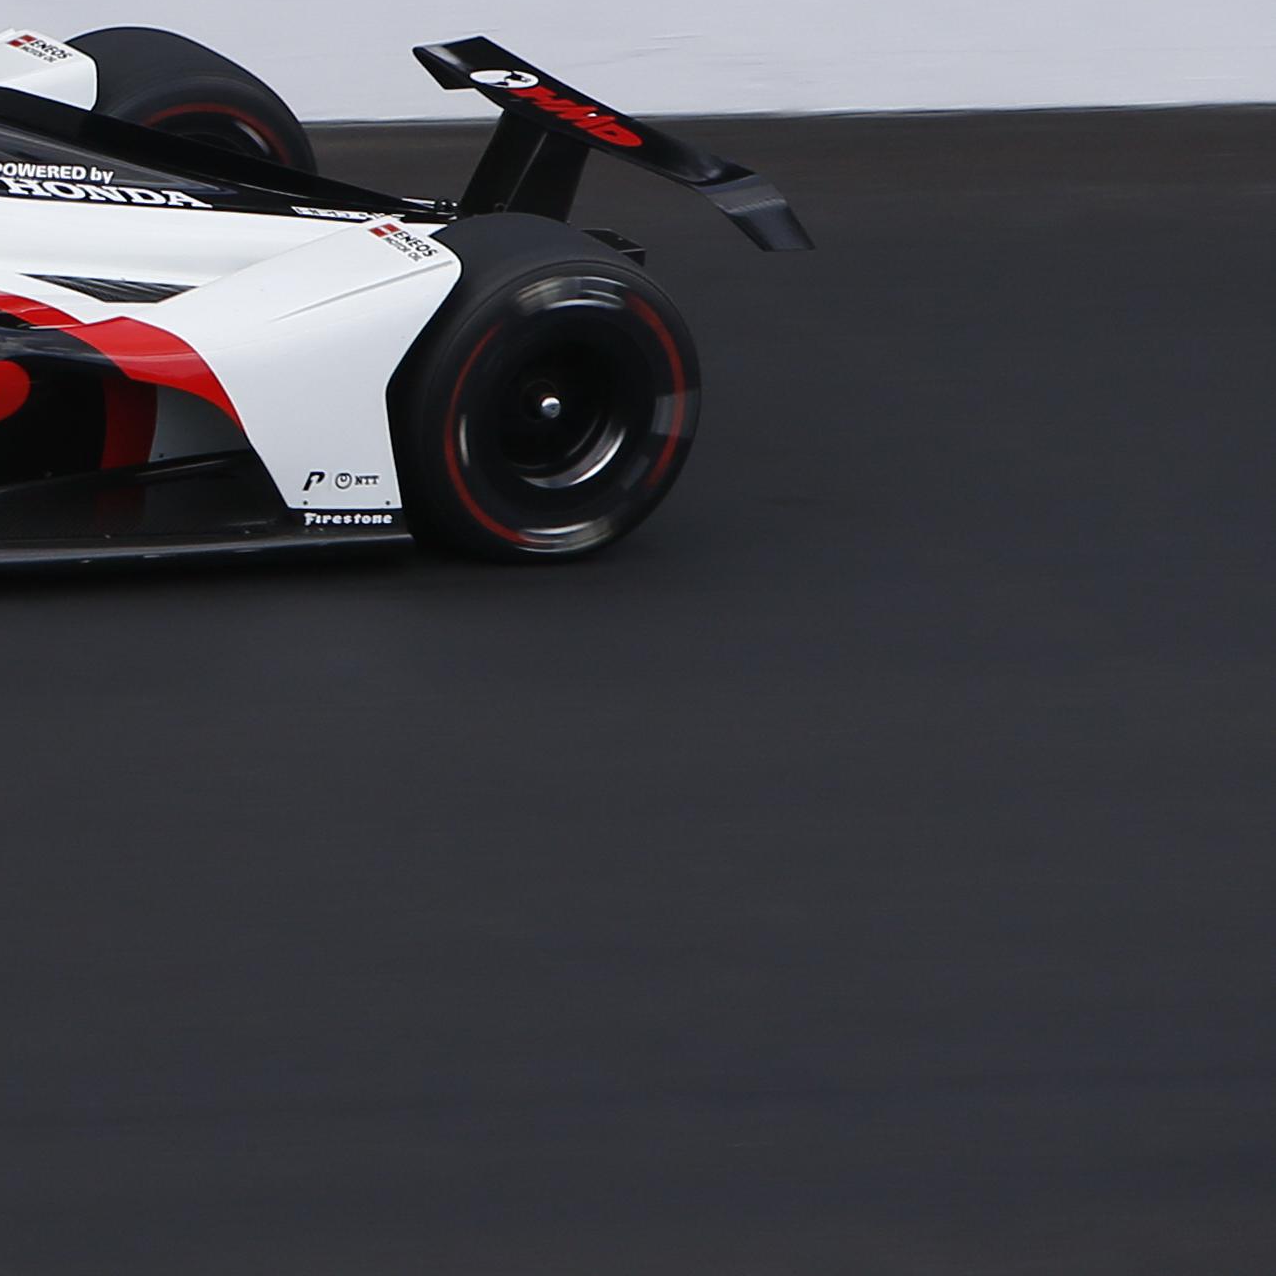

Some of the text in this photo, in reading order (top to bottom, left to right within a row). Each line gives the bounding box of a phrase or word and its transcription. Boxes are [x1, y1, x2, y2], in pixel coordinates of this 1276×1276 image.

[506, 86, 643, 148] HMD
[89, 166, 114, 185] by
[394, 229, 438, 258] ENEOS
[355, 475, 380, 486] NTT
[304, 512, 393, 526] Firestone
